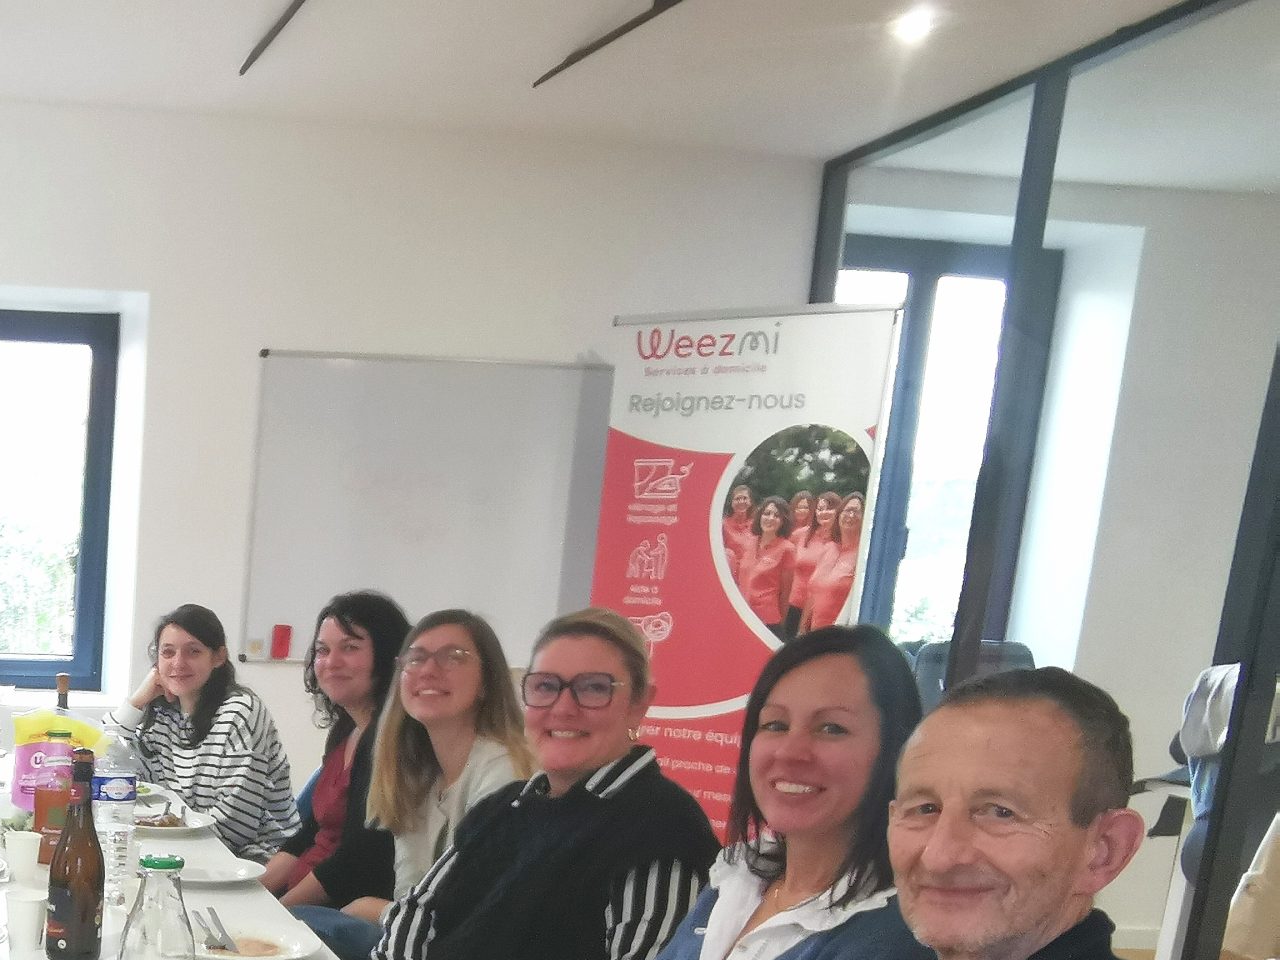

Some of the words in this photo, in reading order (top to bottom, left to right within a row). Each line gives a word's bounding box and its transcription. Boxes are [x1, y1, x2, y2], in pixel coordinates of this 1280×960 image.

[637, 321, 783, 360] Weezmi
[629, 392, 807, 418] Rejoignez-nous
[664, 727, 702, 741] notre
